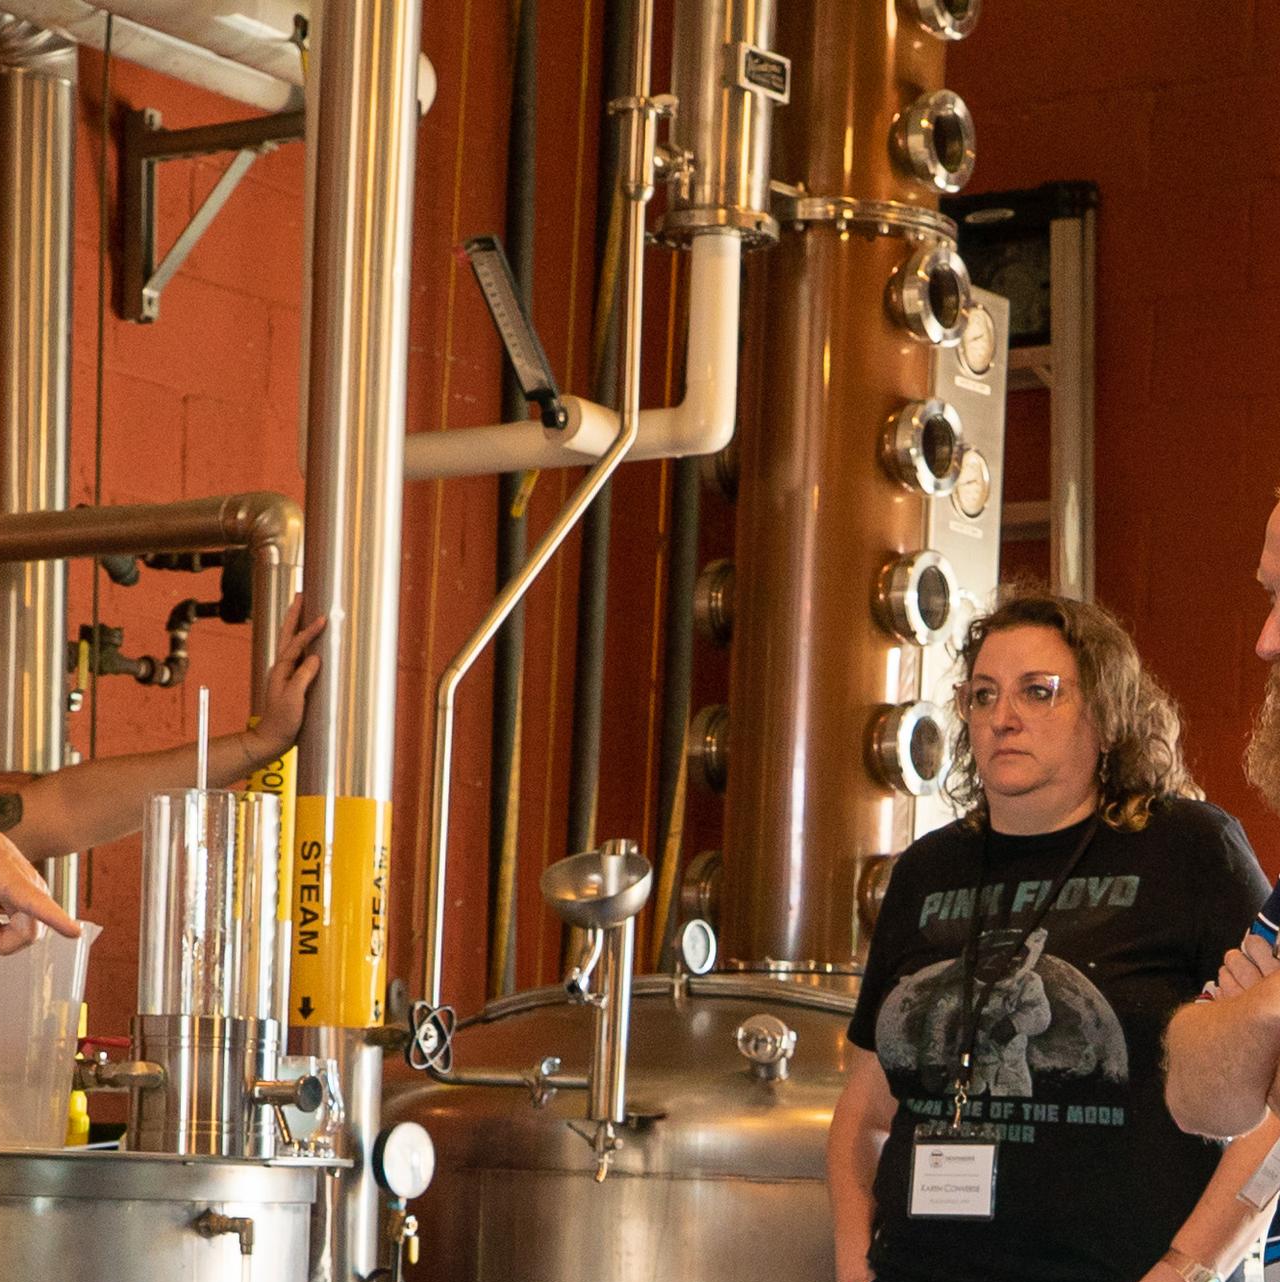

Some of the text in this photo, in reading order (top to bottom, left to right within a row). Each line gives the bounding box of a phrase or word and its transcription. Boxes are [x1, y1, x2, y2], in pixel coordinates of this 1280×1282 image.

[298, 840, 322, 956] STEAM
[1012, 874, 1140, 912] FLOYD
[990, 1101, 1014, 1120] OF
[1023, 1102, 1060, 1123] THE
[1067, 1104, 1125, 1126] MOON
